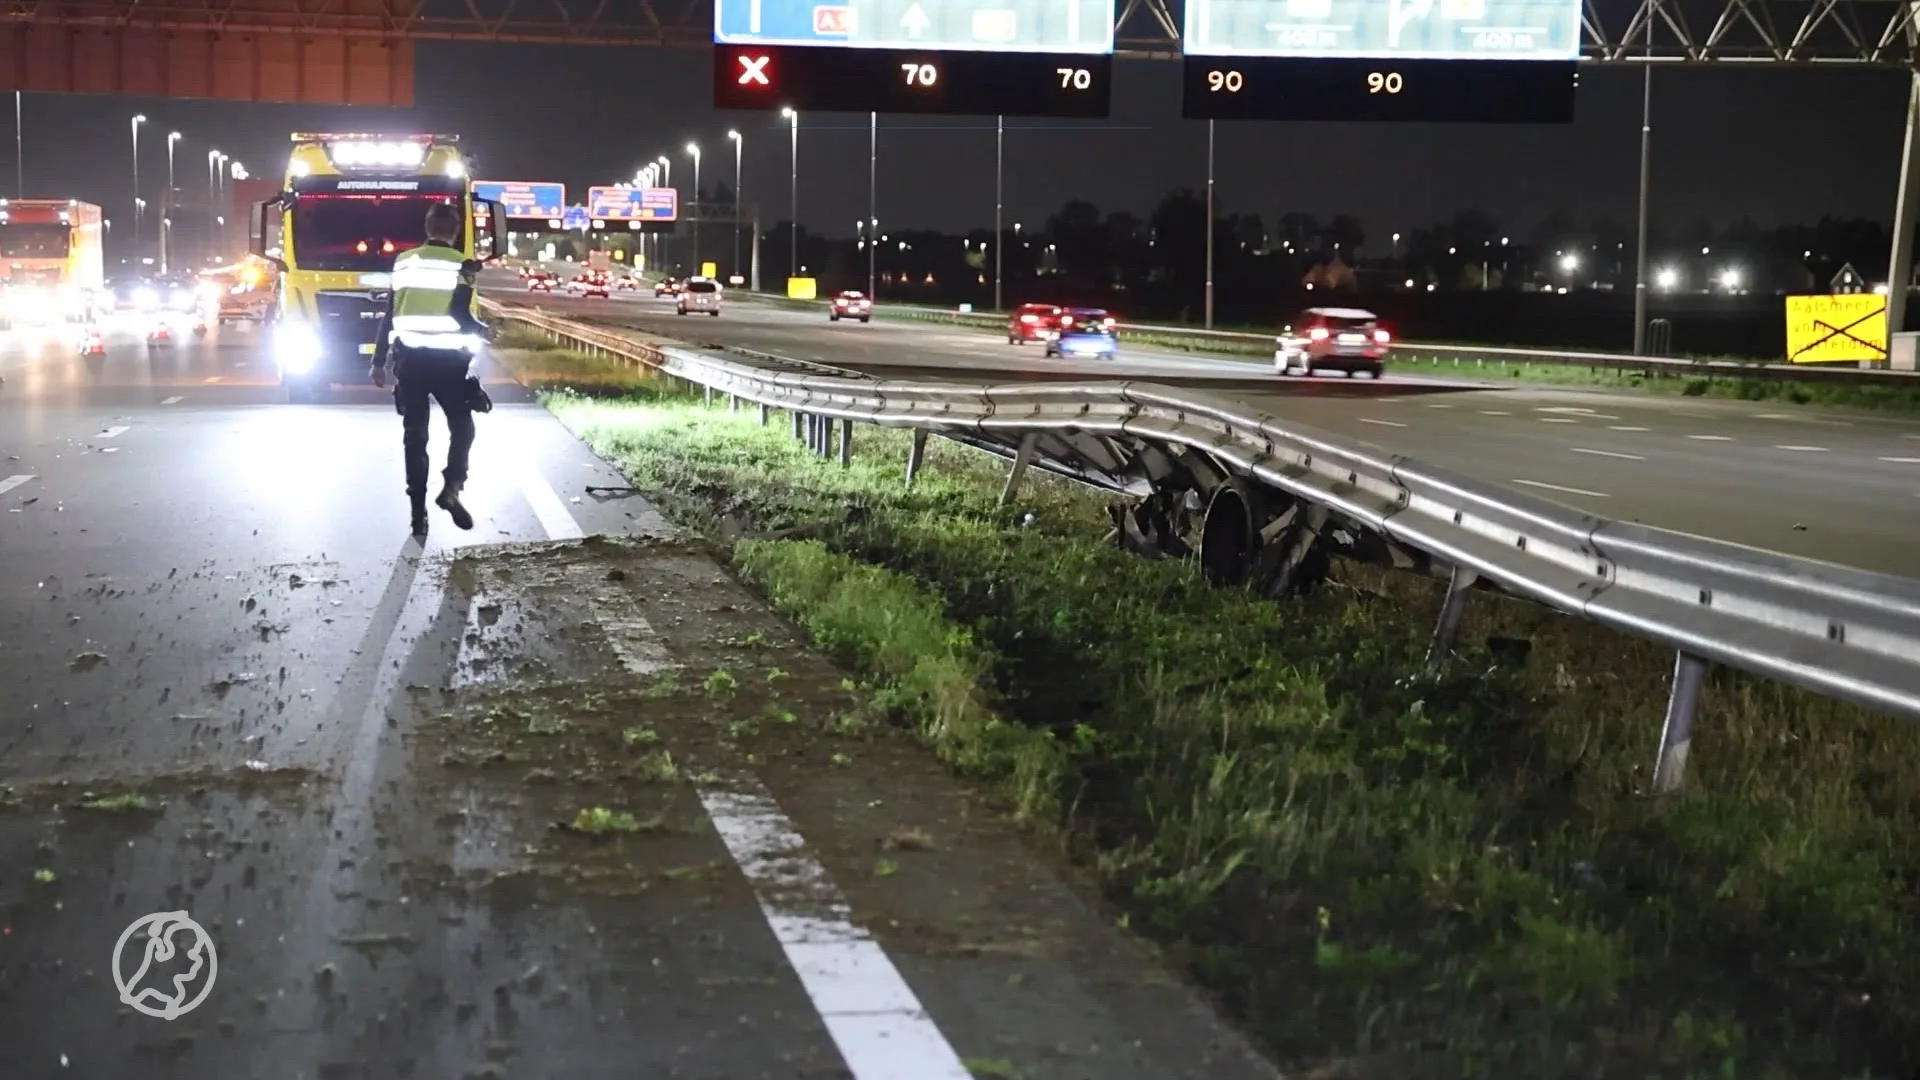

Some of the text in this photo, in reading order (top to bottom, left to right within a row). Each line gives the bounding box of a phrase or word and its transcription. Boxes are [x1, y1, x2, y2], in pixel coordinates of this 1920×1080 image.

[1473, 32, 1533, 48] 400 m
[901, 64, 937, 86] 70
[1057, 68, 1091, 90] 70
[1208, 71, 1243, 92] 90
[1368, 72, 1403, 94] 90
[1793, 300, 1870, 313] Aalsmeer
